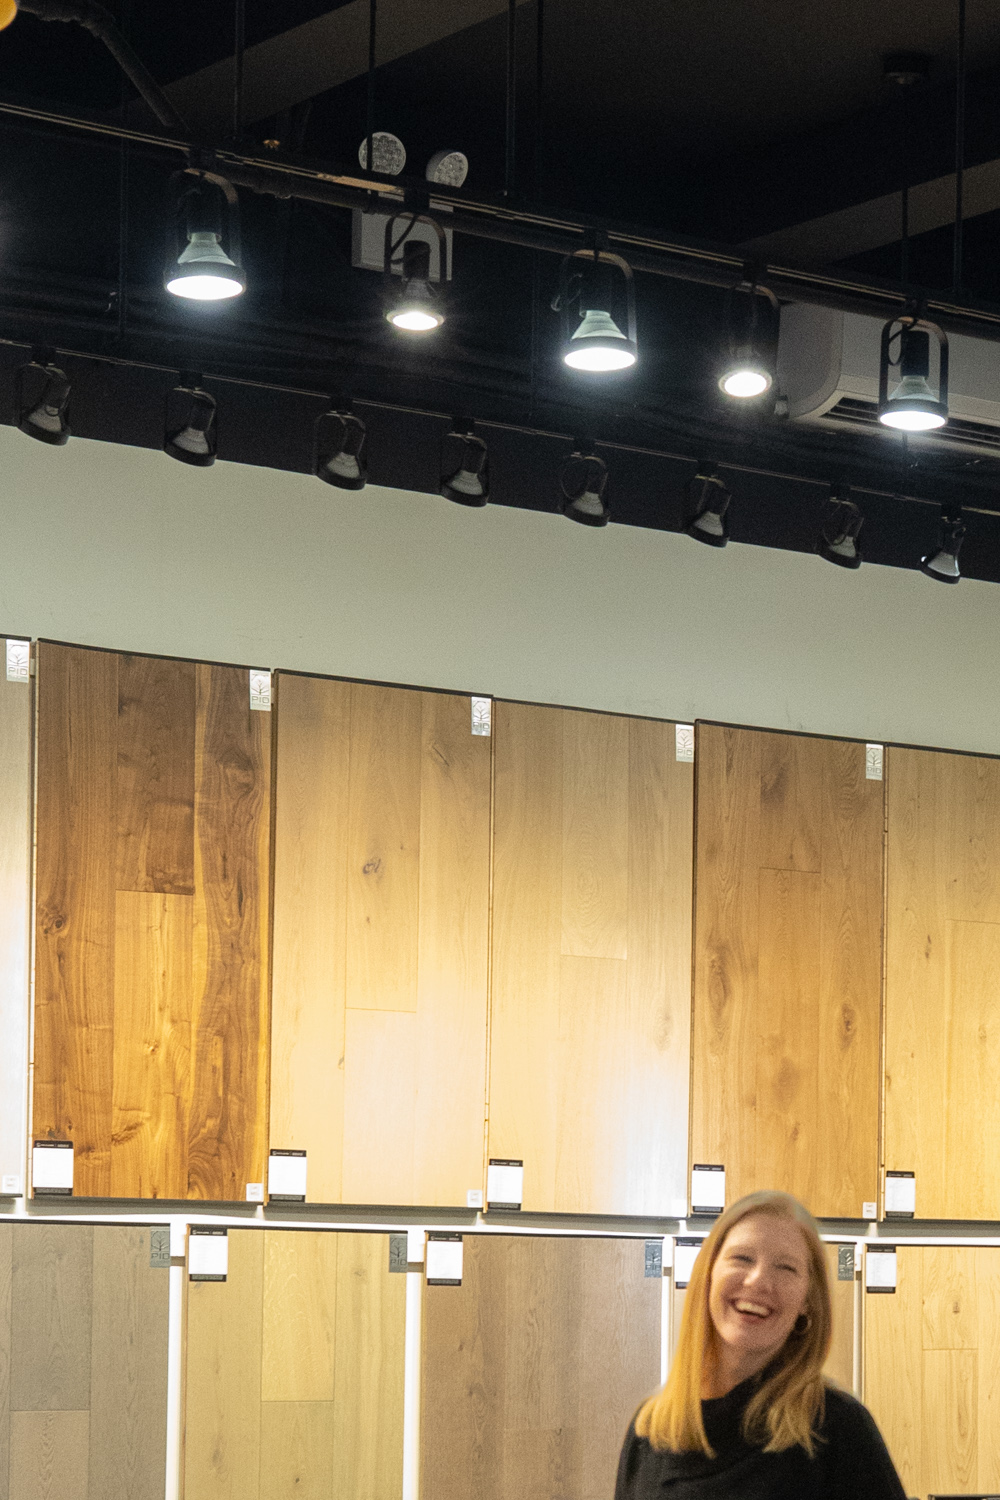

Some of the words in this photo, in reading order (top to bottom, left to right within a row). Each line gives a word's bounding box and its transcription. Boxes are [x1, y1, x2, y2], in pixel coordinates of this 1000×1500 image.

[8, 666, 28, 676] PID
[252, 696, 270, 704] PID
[473, 722, 490, 730] PID
